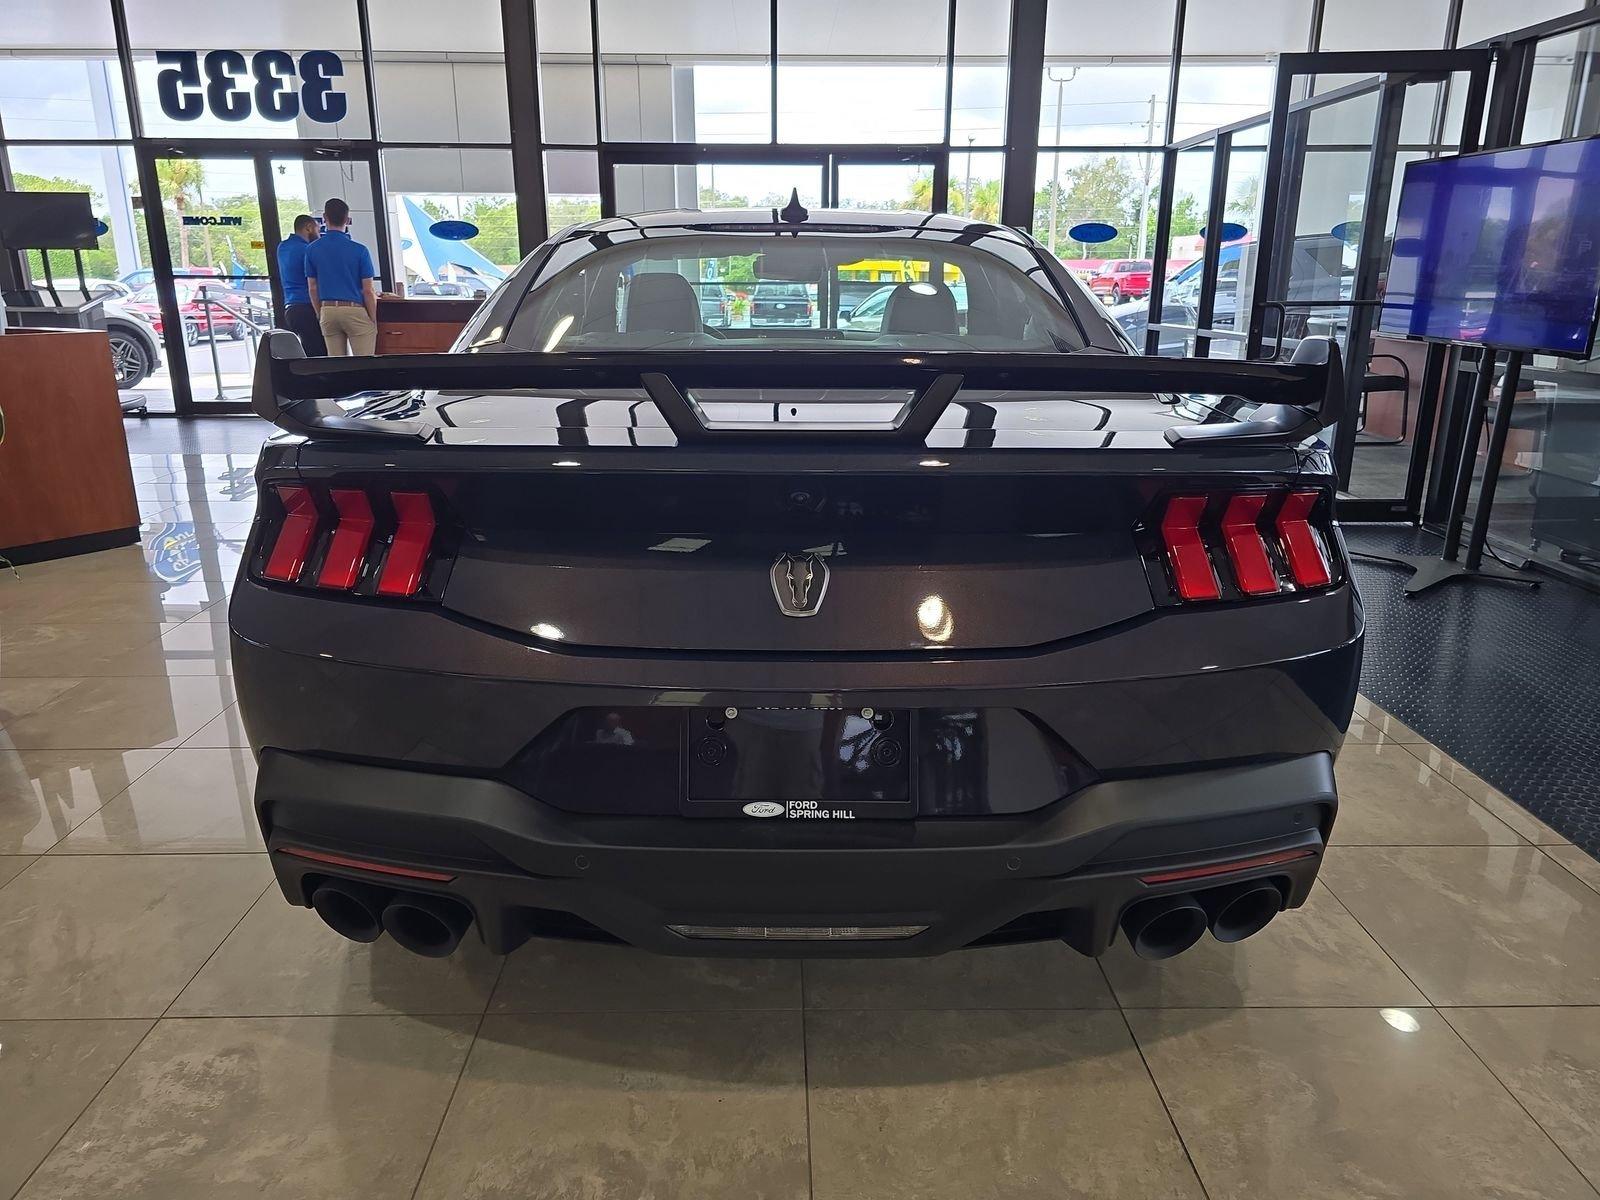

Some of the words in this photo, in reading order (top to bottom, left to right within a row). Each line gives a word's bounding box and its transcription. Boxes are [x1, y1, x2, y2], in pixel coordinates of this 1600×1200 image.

[789, 801, 818, 810] FORD
[789, 810, 830, 819] SPRING
[832, 810, 855, 819] HILL
